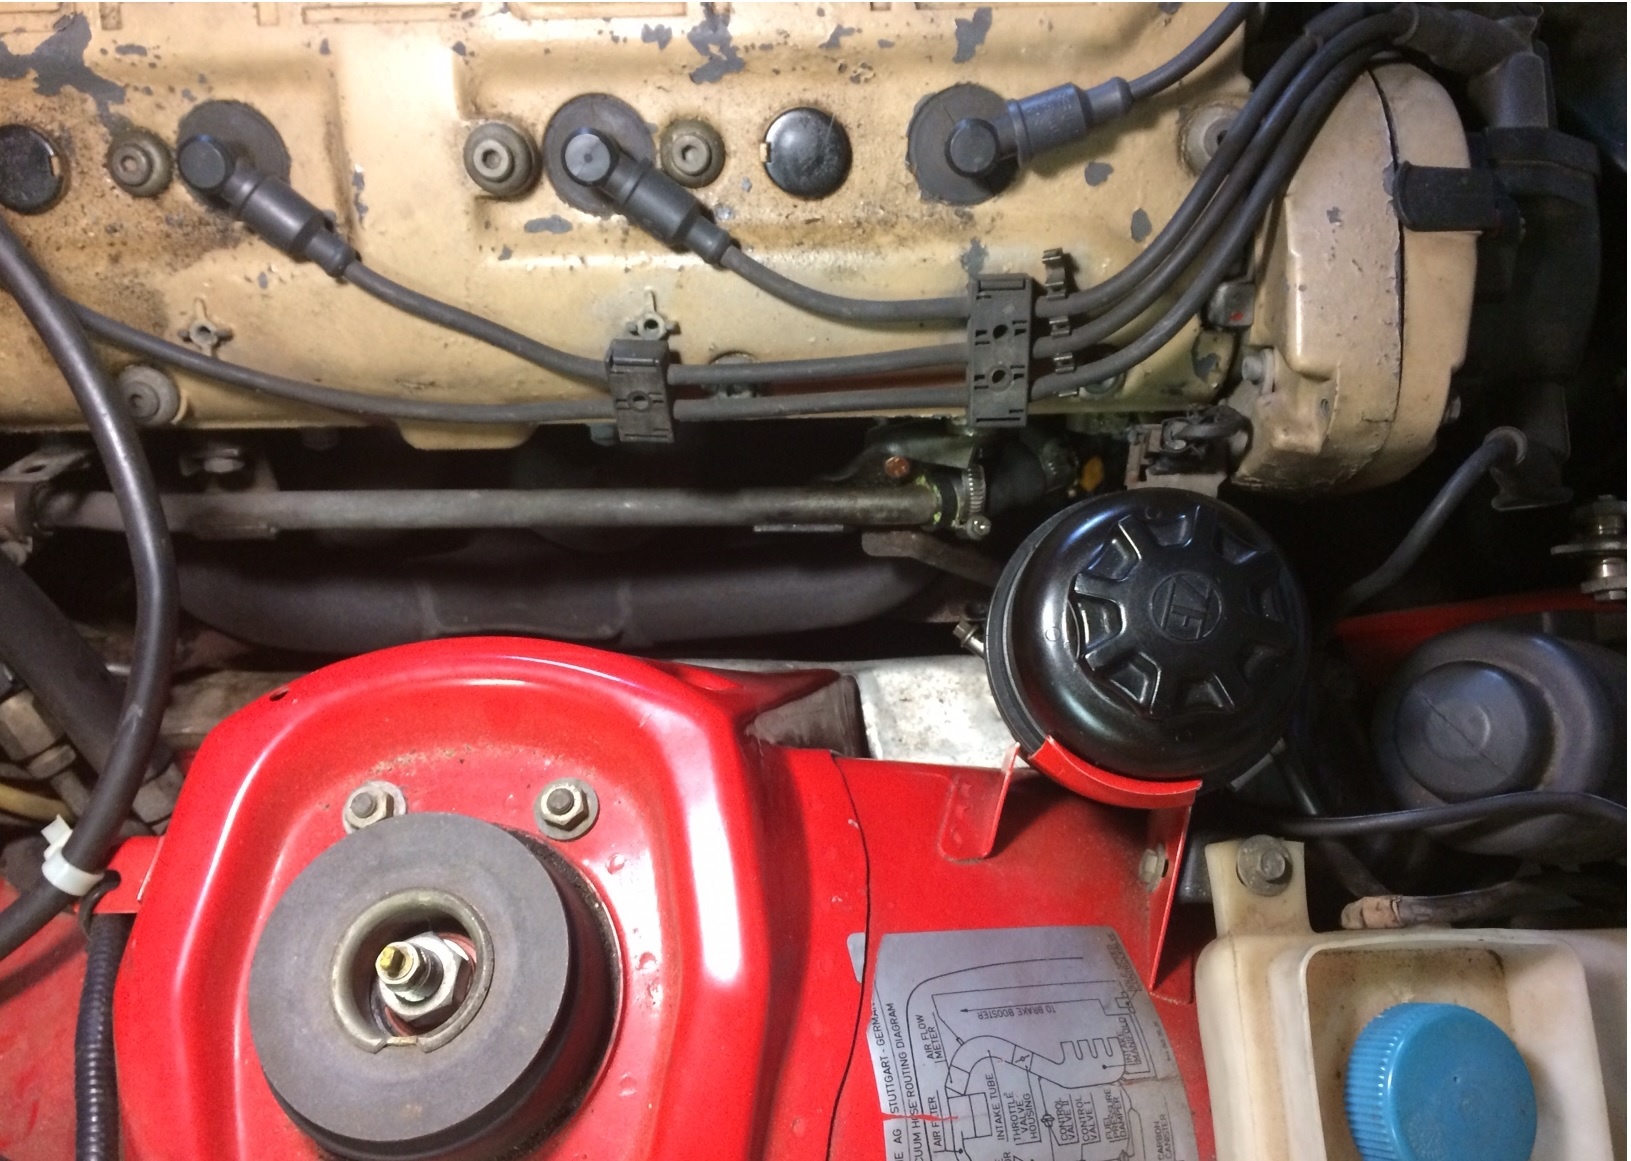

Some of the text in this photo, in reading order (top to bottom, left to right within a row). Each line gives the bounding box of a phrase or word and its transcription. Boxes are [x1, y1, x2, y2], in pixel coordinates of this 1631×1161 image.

[885, 1003, 905, 1049] DIAGRAM
[977, 1005, 1056, 1020] TO BRAKE BOOSTER
[915, 1014, 935, 1060] AIR FLOW
[928, 1026, 943, 1059] METER
[880, 1056, 900, 1113] STUTTGART
[898, 1052, 916, 1098] ROUTING
[985, 1073, 998, 1099] TUBE
[892, 1128, 903, 1144] AG
[992, 1103, 1005, 1141] INTAKE
[1006, 1091, 1021, 1141] THROTTLE
[1015, 1101, 1028, 1133] VALVE
[1023, 1093, 1038, 1139] HOUSING
[1054, 1097, 1069, 1141] CONTROL
[1064, 1110, 1075, 1140] VALVE
[1075, 1098, 1090, 1141] CONTROL
[1088, 1110, 1098, 1140] VALVE
[1102, 1115, 1113, 1140] FUEL
[1112, 1096, 1127, 1138] DAMPER
[933, 1130, 942, 1147] AIR
[1153, 1121, 1165, 1161] CARBON
[1160, 1114, 1172, 1160] CANISTER
